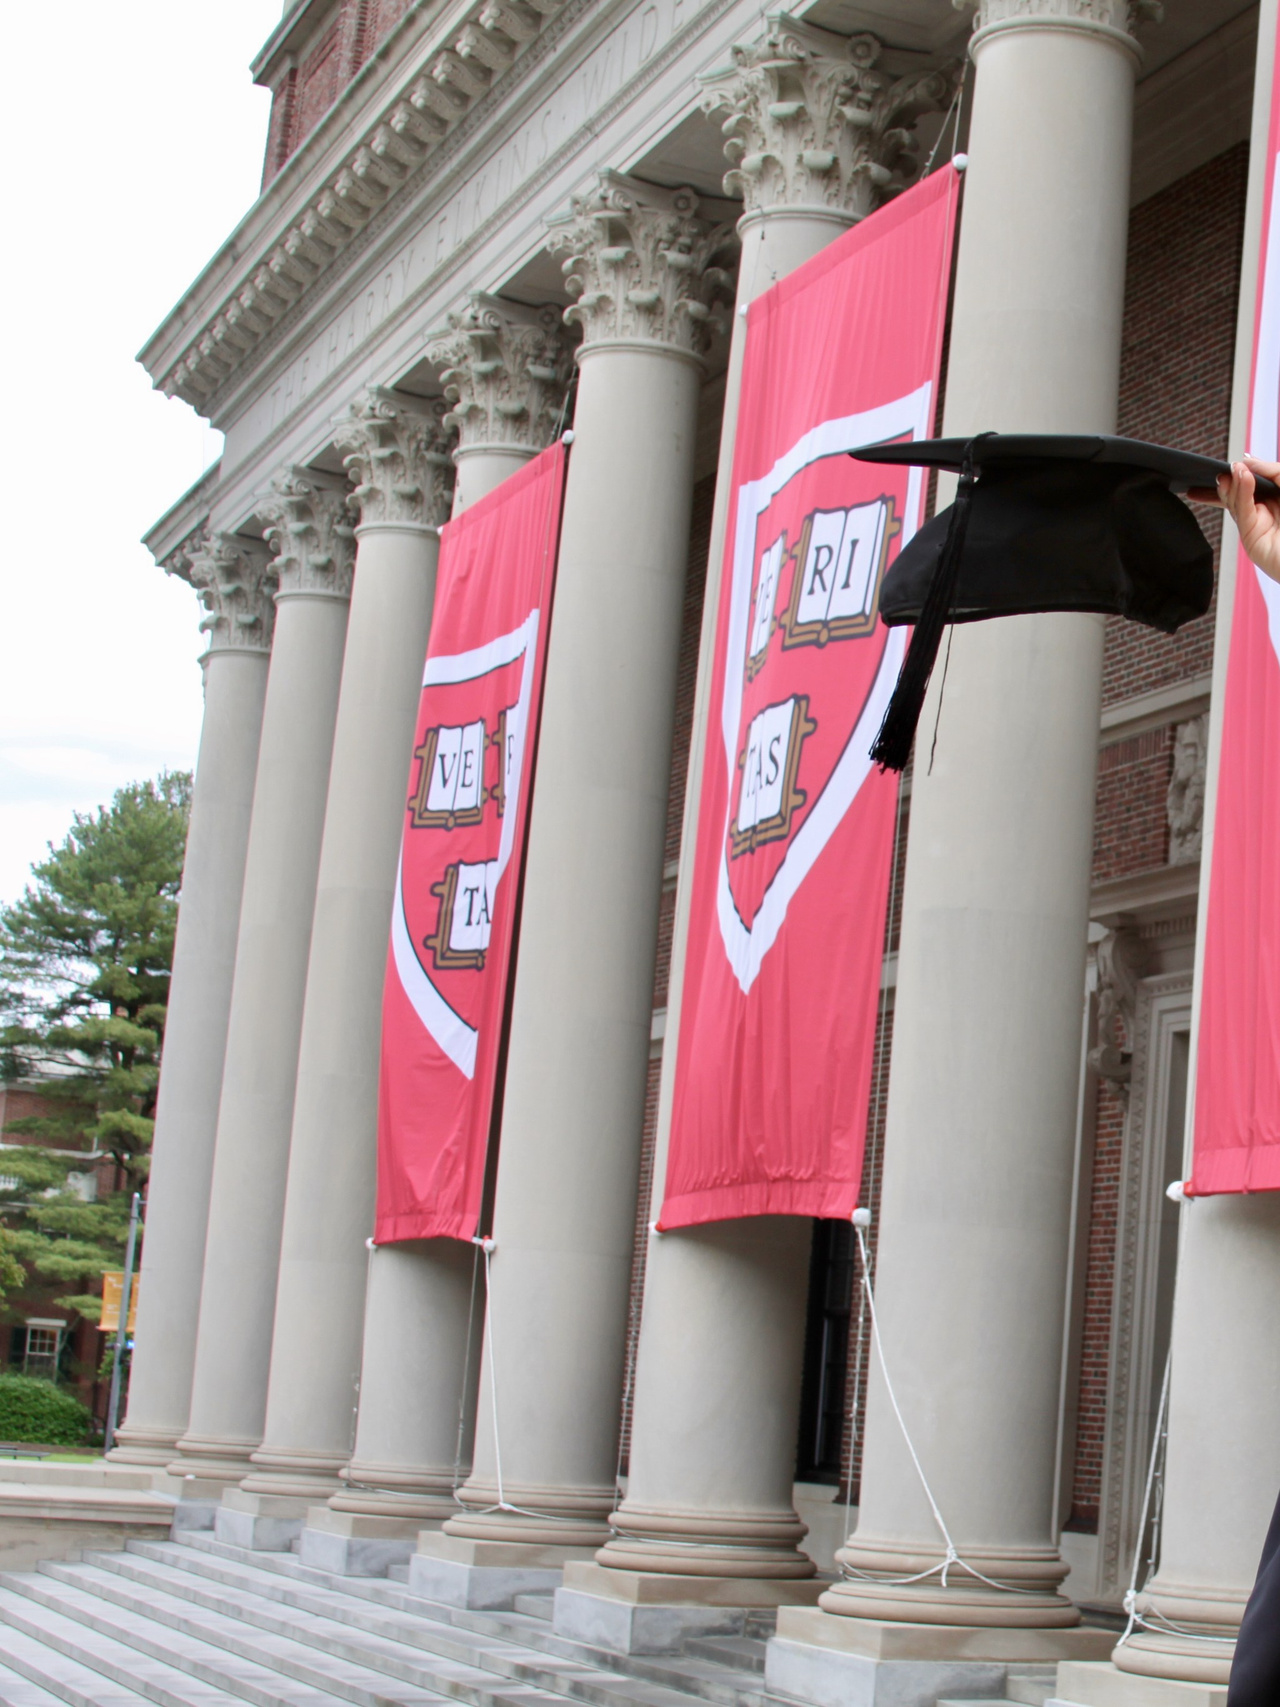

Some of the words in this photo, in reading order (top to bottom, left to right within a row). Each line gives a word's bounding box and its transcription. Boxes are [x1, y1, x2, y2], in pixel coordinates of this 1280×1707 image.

[270, 356, 310, 429] THE
[326, 248, 415, 376] HARRY
[433, 109, 551, 268] ELKINS
[807, 538, 860, 596] RI
[438, 749, 474, 789] VE
